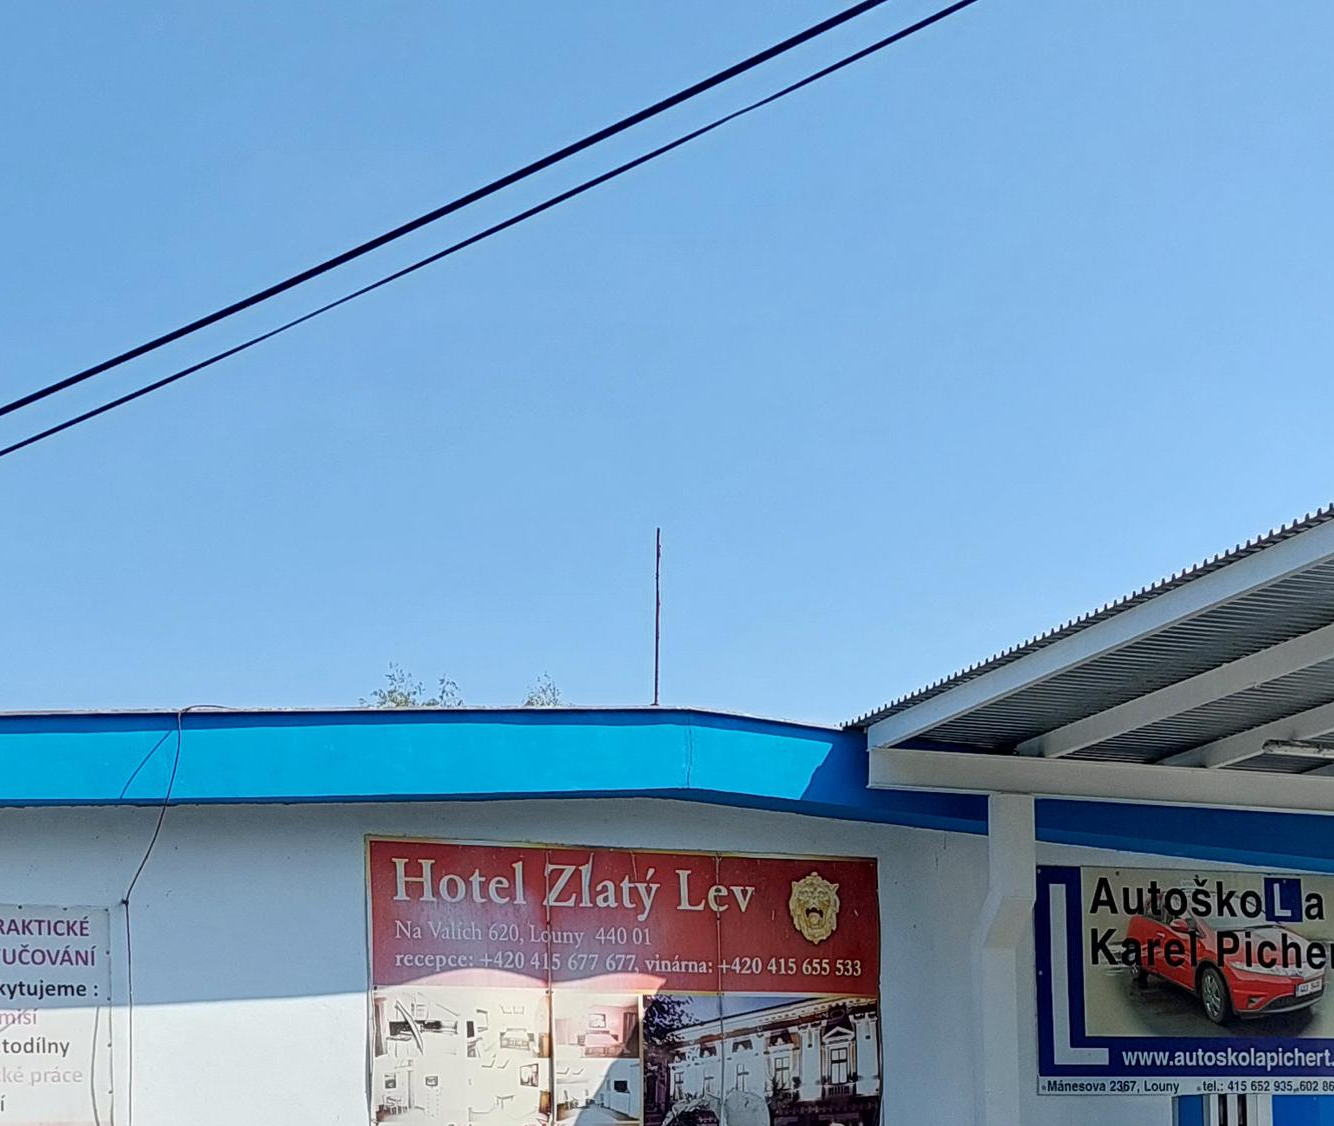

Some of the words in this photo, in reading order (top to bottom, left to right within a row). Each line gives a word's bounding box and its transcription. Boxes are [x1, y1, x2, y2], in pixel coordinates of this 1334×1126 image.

[392, 858, 527, 906] Hotel
[544, 863, 661, 921] Zlatý
[675, 869, 755, 913] Lev
[395, 921, 422, 939] Na
[489, 924, 524, 945] 620,
[529, 924, 584, 949] Louny
[596, 927, 627, 945] 440
[633, 928, 651, 945] 01
[1090, 927, 1197, 967] Karel
[395, 953, 474, 971] recepce:
[480, 951, 524, 969] +420
[530, 952, 561, 970] 415
[568, 953, 598, 970] 677
[605, 954, 639, 973] 677,
[645, 954, 713, 974] vinárna:
[718, 957, 762, 975] +420
[767, 957, 796, 974] 415
[802, 958, 830, 976] 655
[835, 959, 862, 976] 533
[30, 1067, 83, 1086] práce
[1047, 1079, 1106, 1092] Mánesova
[1109, 1080, 1142, 1094] 2367,
[1144, 1080, 1179, 1095] Louny
[1202, 1080, 1225, 1092] tel.:
[1227, 1081, 1248, 1092] 415
[1250, 1081, 1271, 1092] 652
[1299, 1081, 1321, 1092] 602
